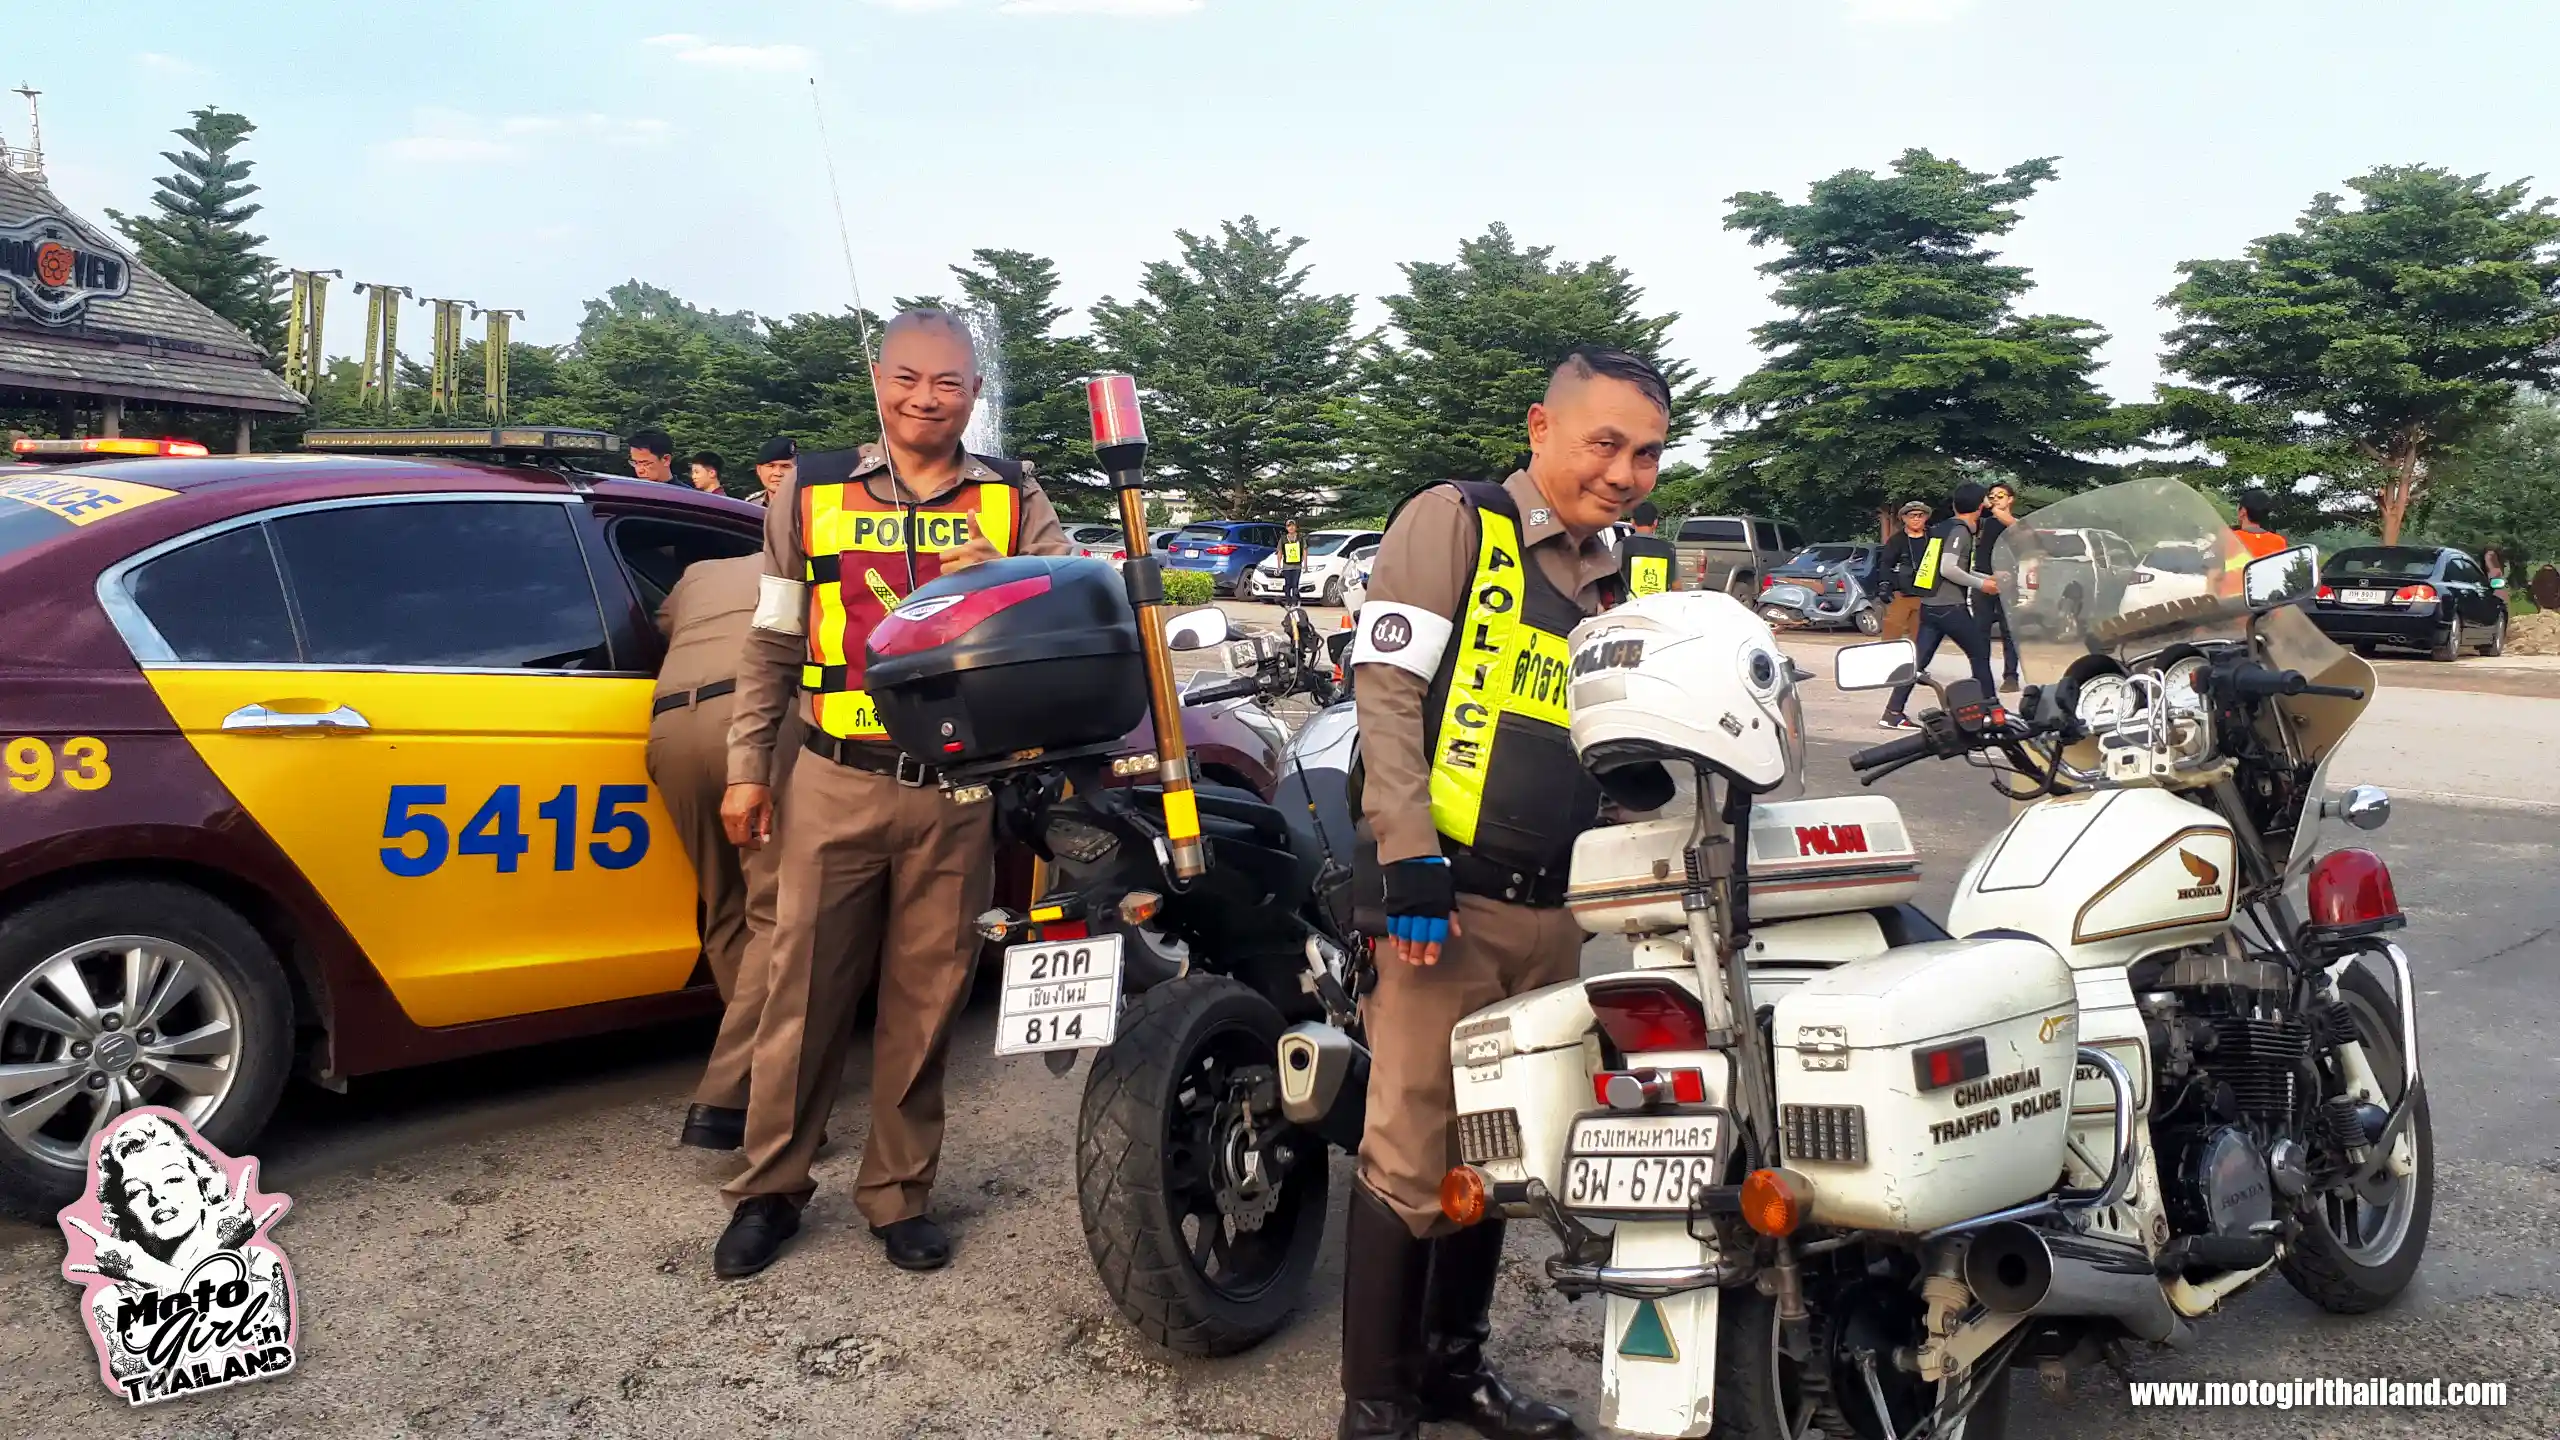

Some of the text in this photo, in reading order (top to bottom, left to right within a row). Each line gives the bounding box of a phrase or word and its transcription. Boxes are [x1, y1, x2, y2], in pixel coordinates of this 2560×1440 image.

[74, 250, 120, 290] VIEW
[1446, 546, 1515, 769] POLICE
[5, 737, 111, 793] 93
[379, 784, 650, 877] 5415
[2177, 884, 2222, 900] HONDA
[1030, 947, 1091, 980] 2กค
[1029, 982, 1087, 1008] เชียงใหม่
[1026, 1013, 1082, 1044] 814
[1929, 1088, 2063, 1145] TRAFFIC POLICE
